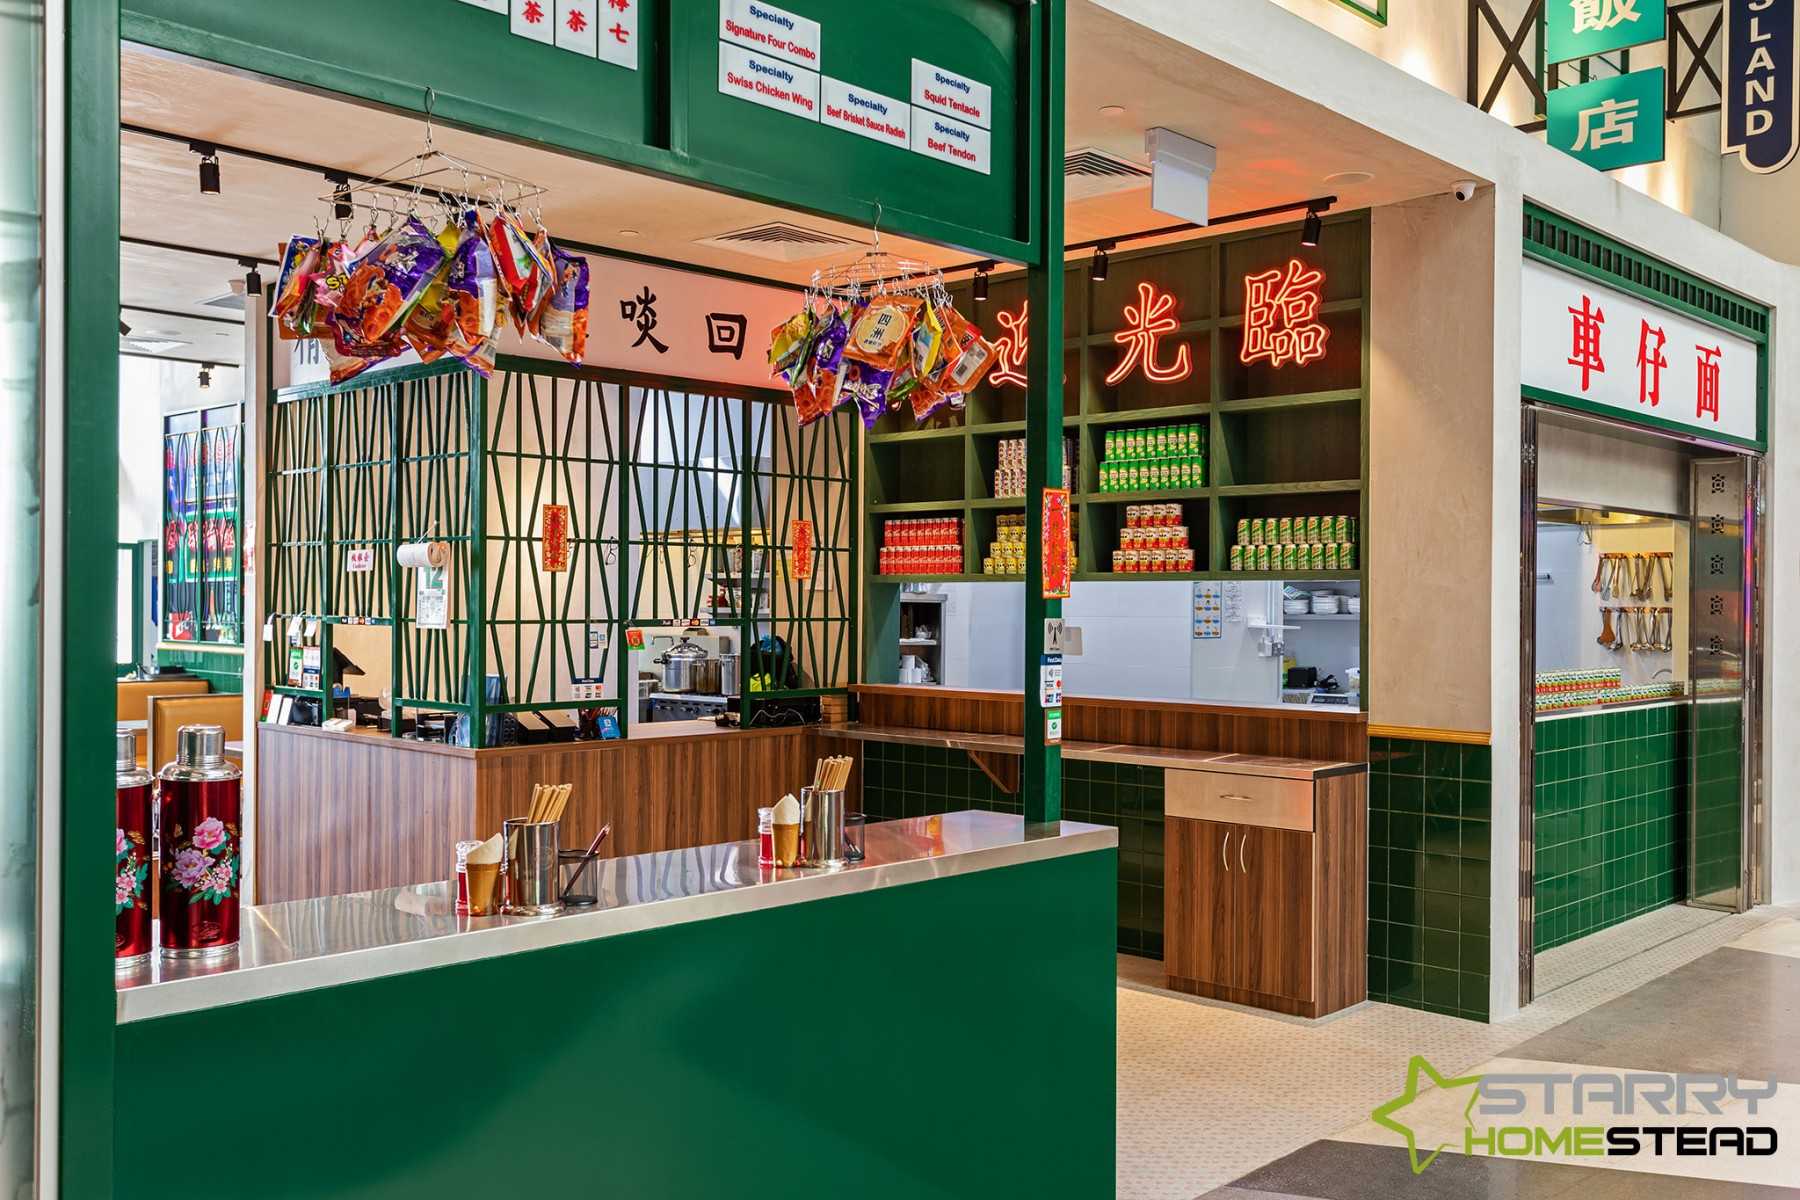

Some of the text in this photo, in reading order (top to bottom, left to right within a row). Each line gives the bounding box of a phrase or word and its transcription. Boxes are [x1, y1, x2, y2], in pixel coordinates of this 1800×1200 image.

[522, 0, 544, 24] 茶
[566, 9, 588, 32] 茶
[749, 5, 794, 30] Specialty
[725, 19, 816, 60] Signature Four Combo
[749, 60, 793, 84] Specialty
[935, 72, 971, 94] Specialty
[727, 72, 813, 111] Swiss Chicken Wing
[924, 89, 981, 118] Squid Tentacle
[848, 93, 888, 116] Specialty
[827, 105, 906, 139] Beef Brisket Sauce Radish
[934, 121, 970, 142] Specialty
[927, 137, 976, 162] Beef Tendon
[1567, 294, 1723, 422] 車仔面
